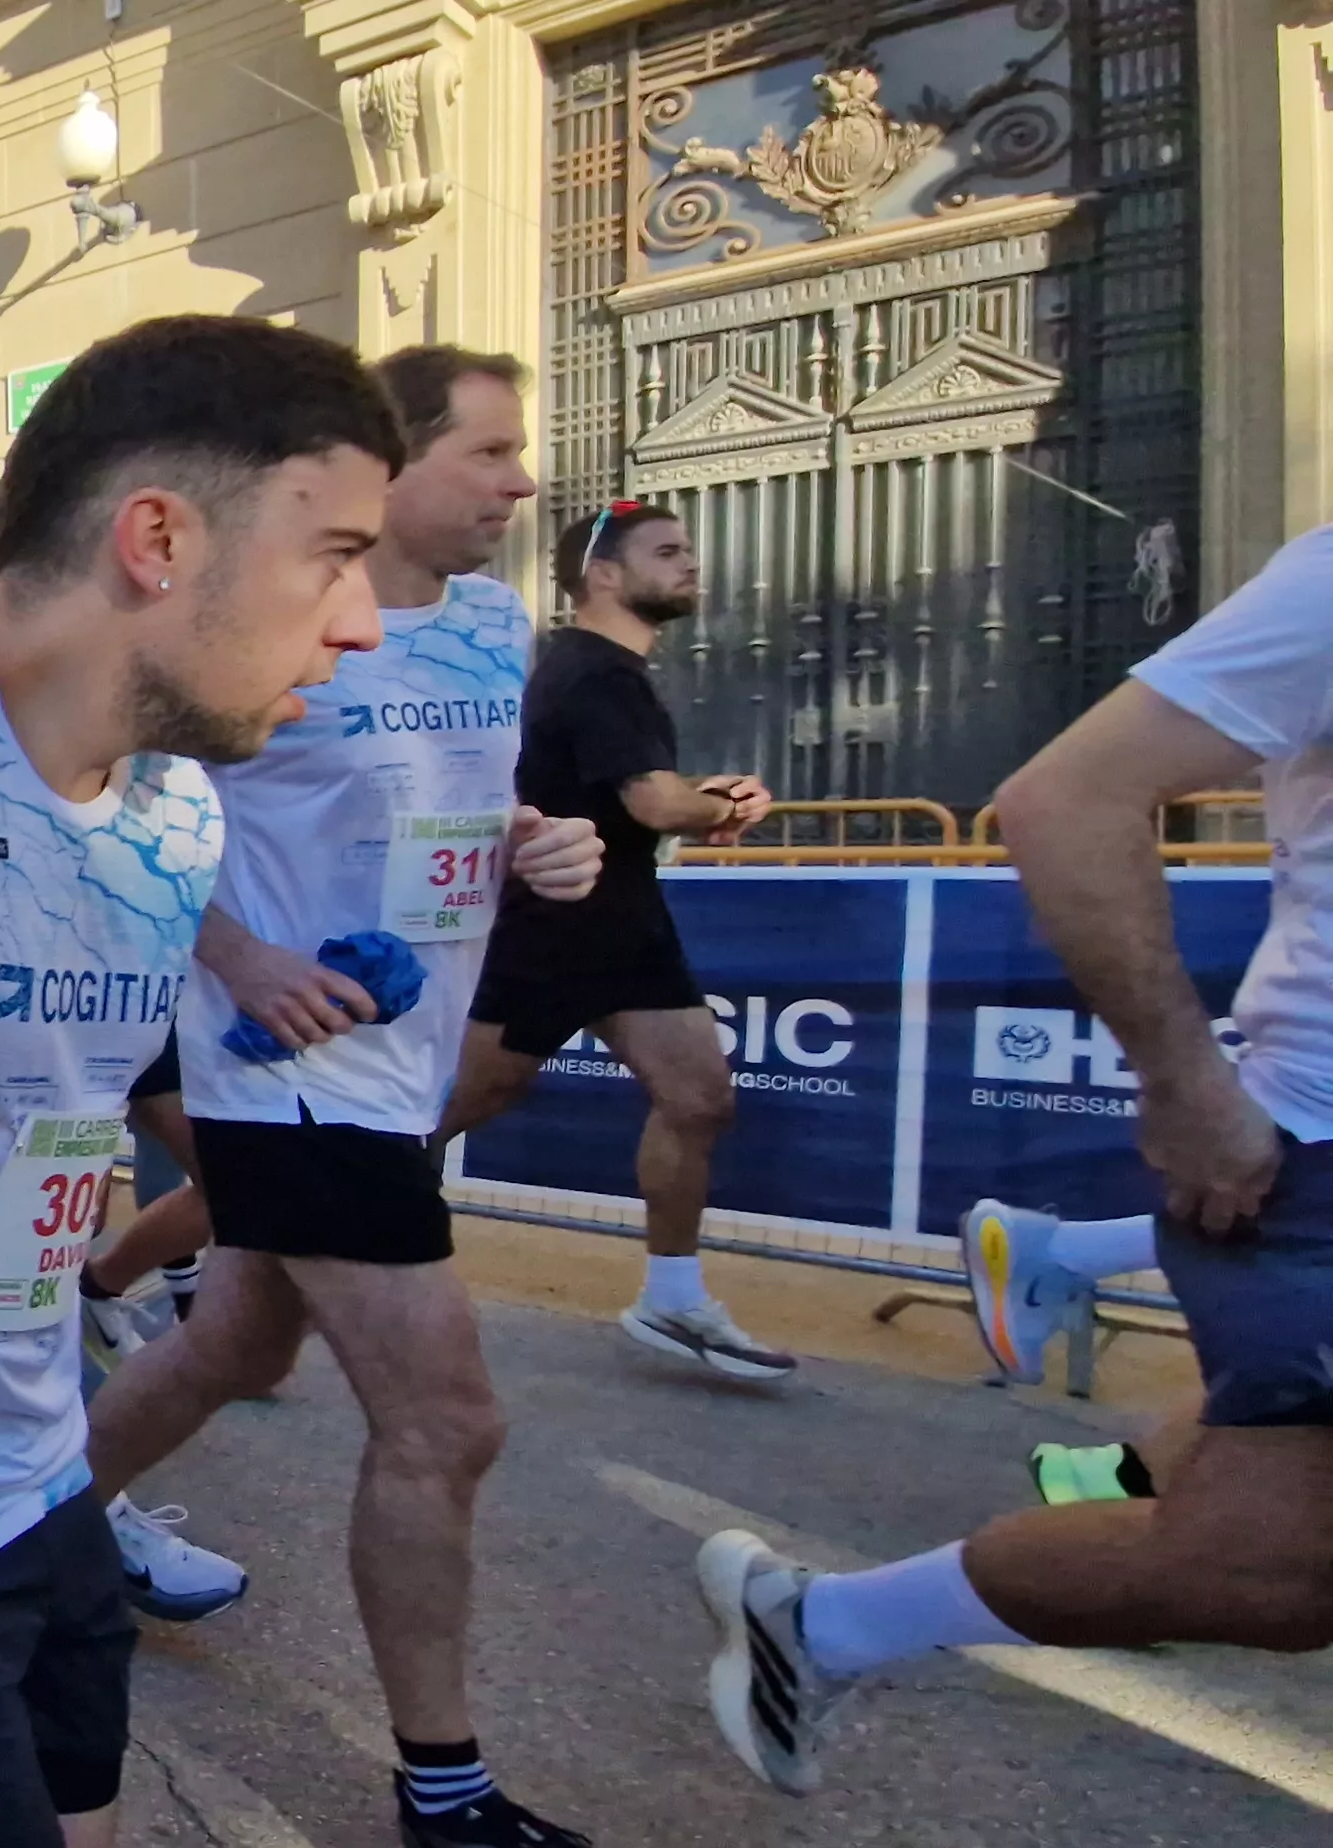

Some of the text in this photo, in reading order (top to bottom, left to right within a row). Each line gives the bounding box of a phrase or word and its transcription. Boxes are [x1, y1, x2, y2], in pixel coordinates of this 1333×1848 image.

[381, 698, 519, 733] COGITIAR
[428, 843, 498, 887] 311
[442, 890, 485, 908] ABEL
[434, 909, 462, 929] 8K
[32, 1171, 99, 1238] 30
[28, 1276, 61, 1309] 8K
